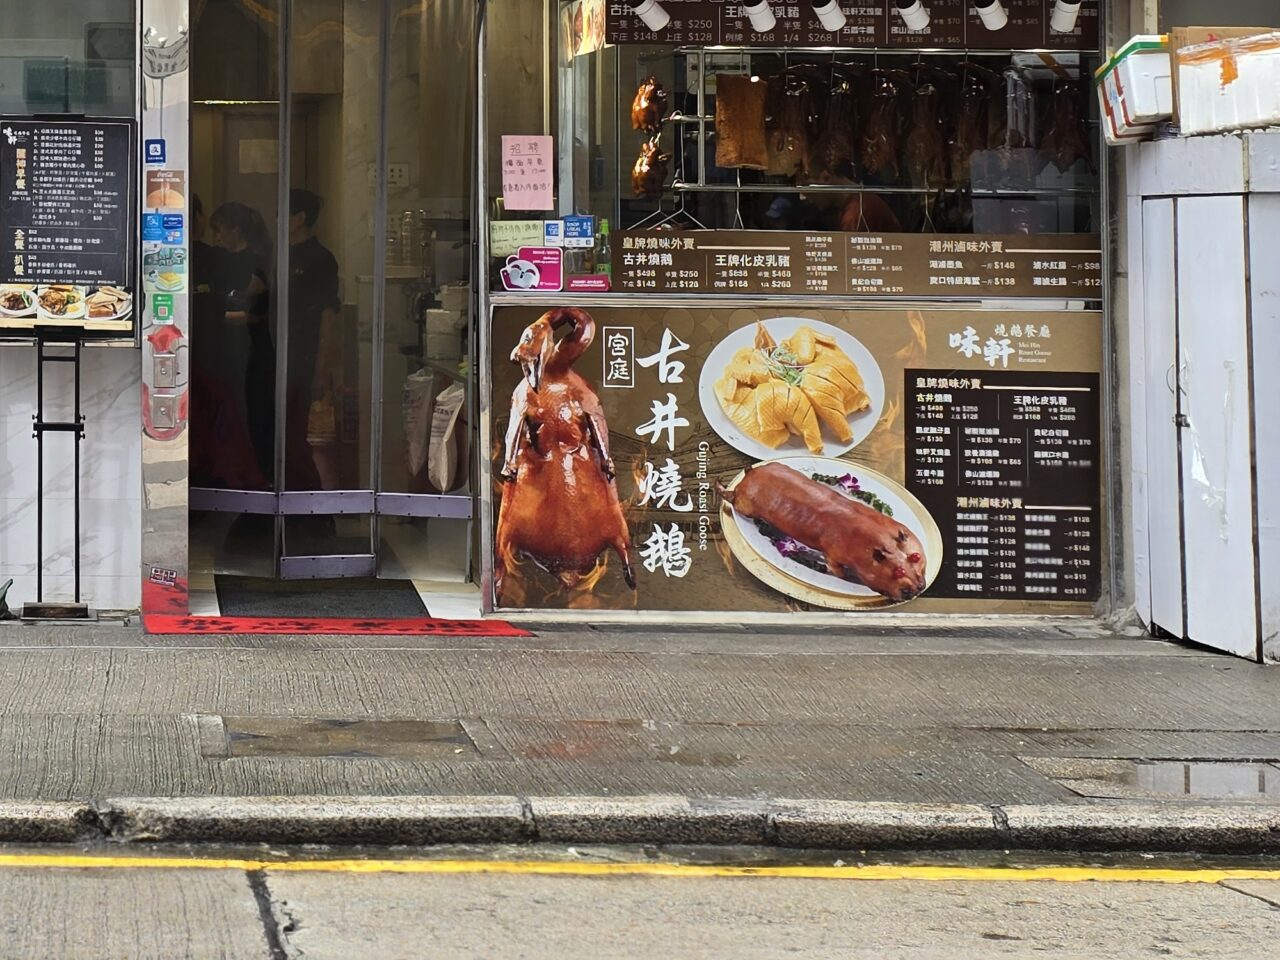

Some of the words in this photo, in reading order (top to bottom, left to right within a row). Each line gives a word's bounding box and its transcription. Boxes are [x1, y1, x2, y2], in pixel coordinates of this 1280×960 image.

[688, 20, 713, 29] $250
[633, 32, 658, 41] $148
[688, 32, 713, 41] $128
[750, 33, 775, 42] $168
[783, 33, 799, 43] 1/4
[808, 33, 832, 42] $268
[622, 237, 695, 250] 皇牌燒味外賣
[929, 241, 1003, 253] 潮州滷味外賣
[622, 252, 673, 266] 古井燒鵝
[714, 253, 790, 267] 王牌化皮乳豬
[994, 260, 1015, 269] $148
[994, 277, 1015, 286] $138
[949, 325, 1015, 368] 味軒
[607, 333, 631, 381] 宮庭
[635, 328, 693, 578] 古井燒鵝
[696, 441, 710, 478] Gujing
[699, 482, 710, 513] Roast
[956, 497, 1022, 509] 潮州滷味外賣
[699, 515, 710, 551] Goose
